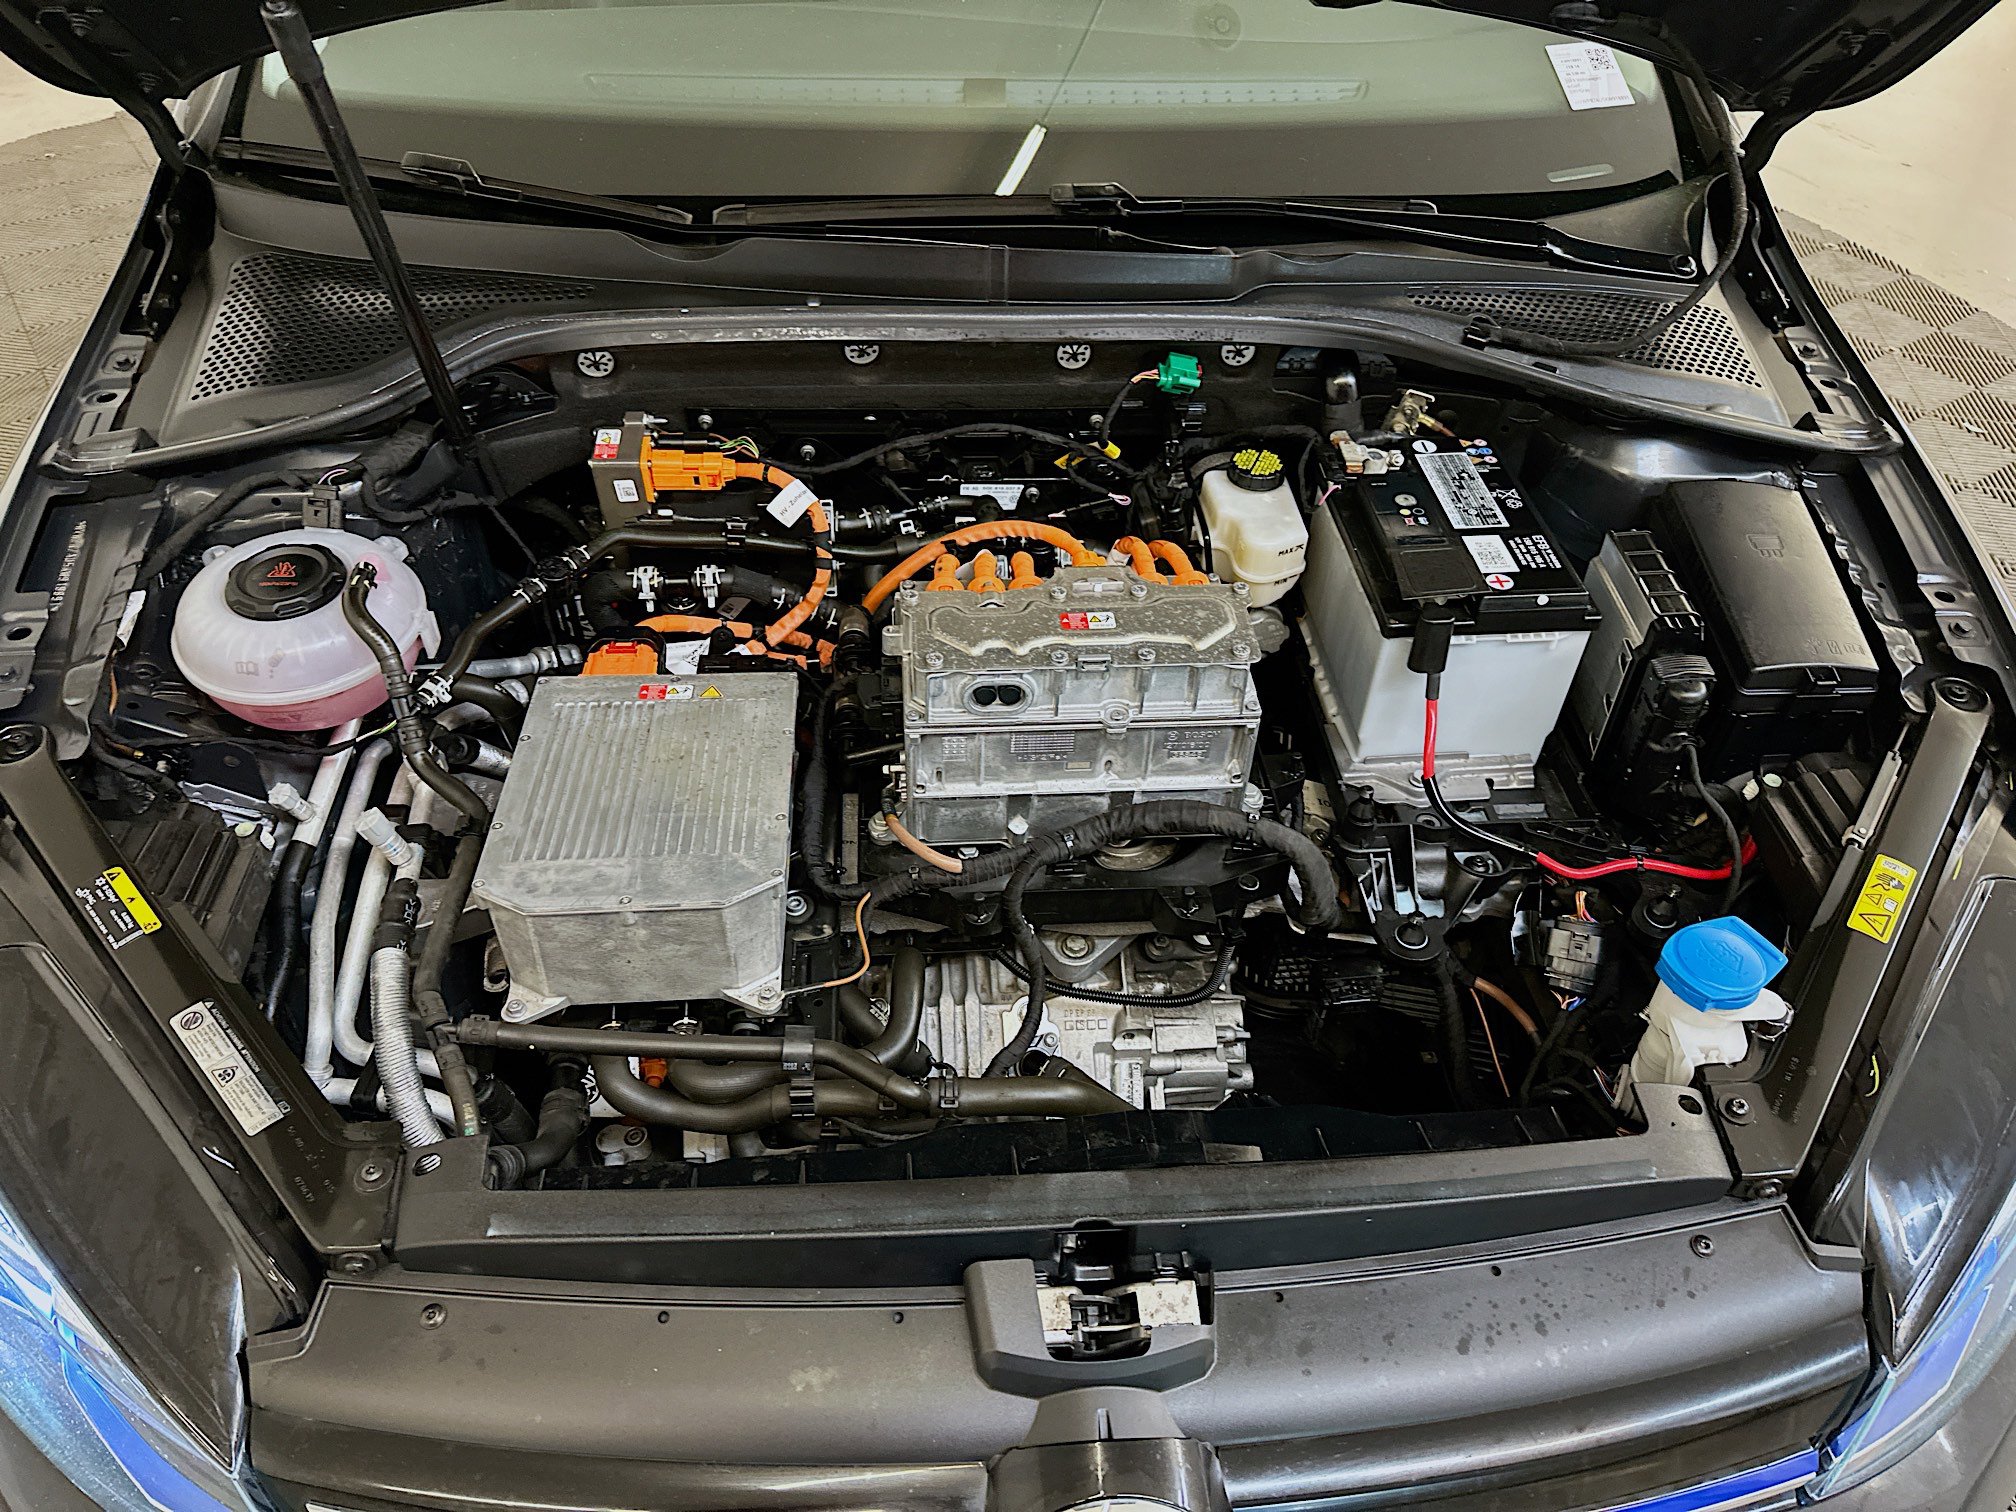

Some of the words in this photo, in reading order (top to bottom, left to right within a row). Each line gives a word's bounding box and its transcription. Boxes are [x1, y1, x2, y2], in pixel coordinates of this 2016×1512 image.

[1531, 534, 1550, 550] EFB
[1277, 546, 1295, 557] MAX
[211, 1007, 229, 1029] ACHTUNG
[225, 1027, 244, 1050] WARNING
[239, 1047, 261, 1073] ATTENTION
